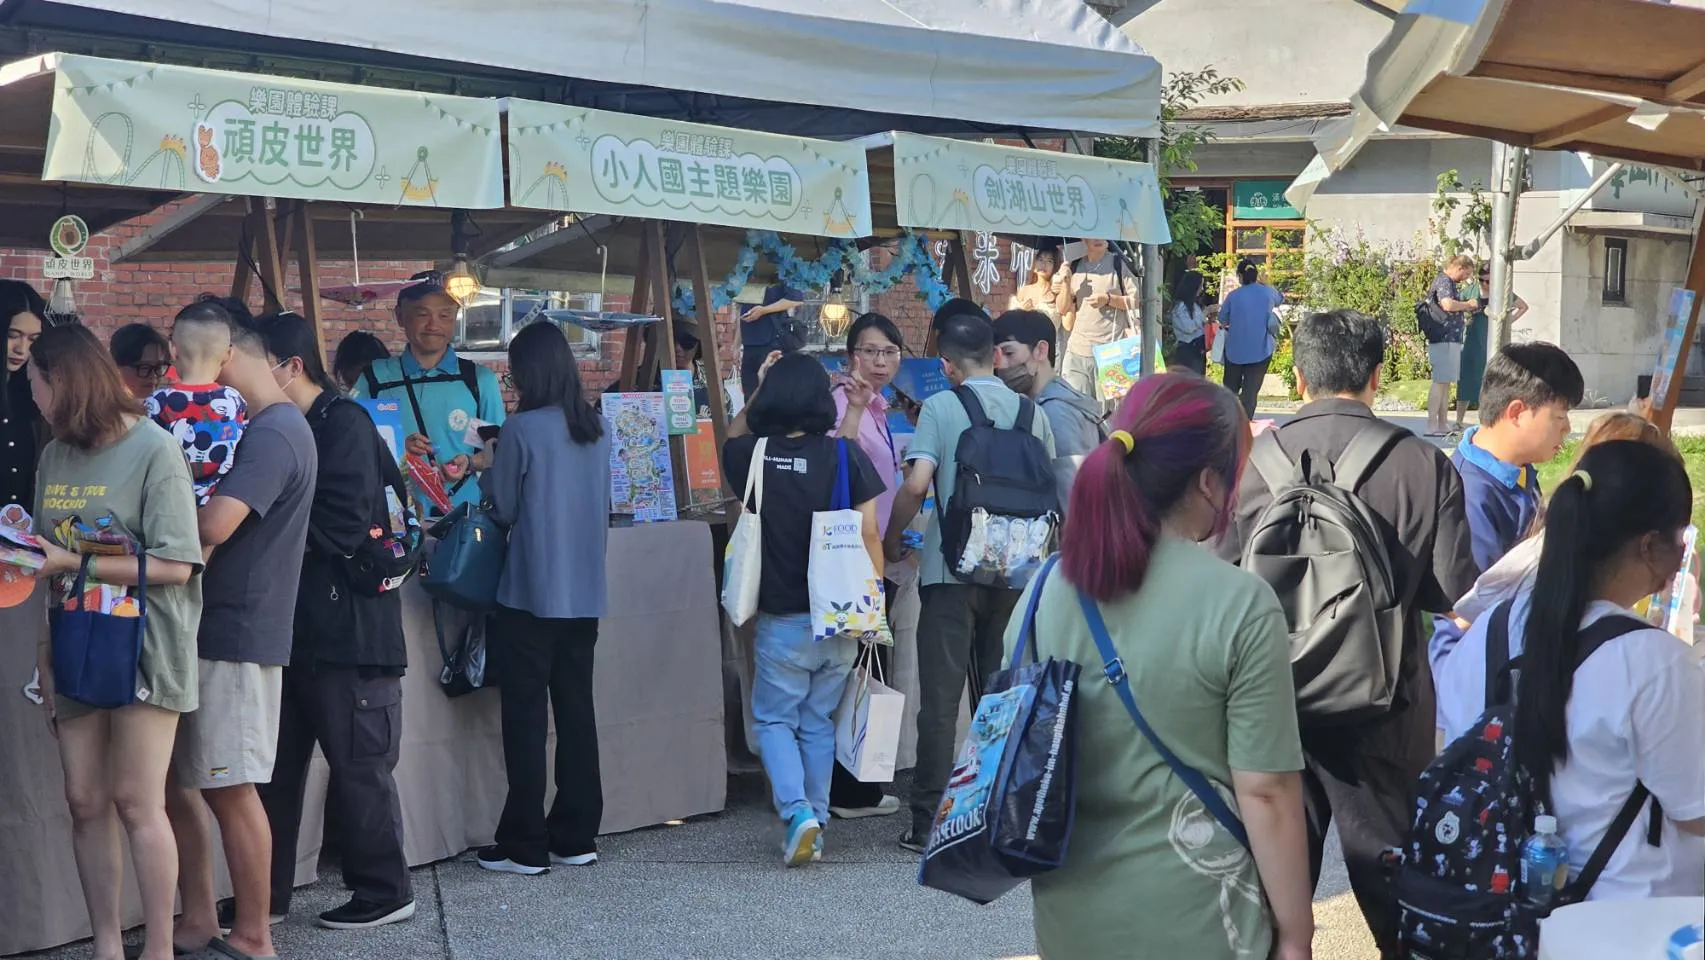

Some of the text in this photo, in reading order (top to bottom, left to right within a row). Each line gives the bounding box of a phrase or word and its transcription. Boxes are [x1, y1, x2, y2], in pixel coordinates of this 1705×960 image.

[249, 87, 338, 122] 樂園體驗課
[223, 118, 358, 172] 頑皮世界
[660, 129, 734, 159] 樂園體驗課
[602, 150, 793, 206] 小人國主題樂園
[984, 176, 1086, 218] 劍湖山世界
[45, 258, 92, 271] 頑皮世界
